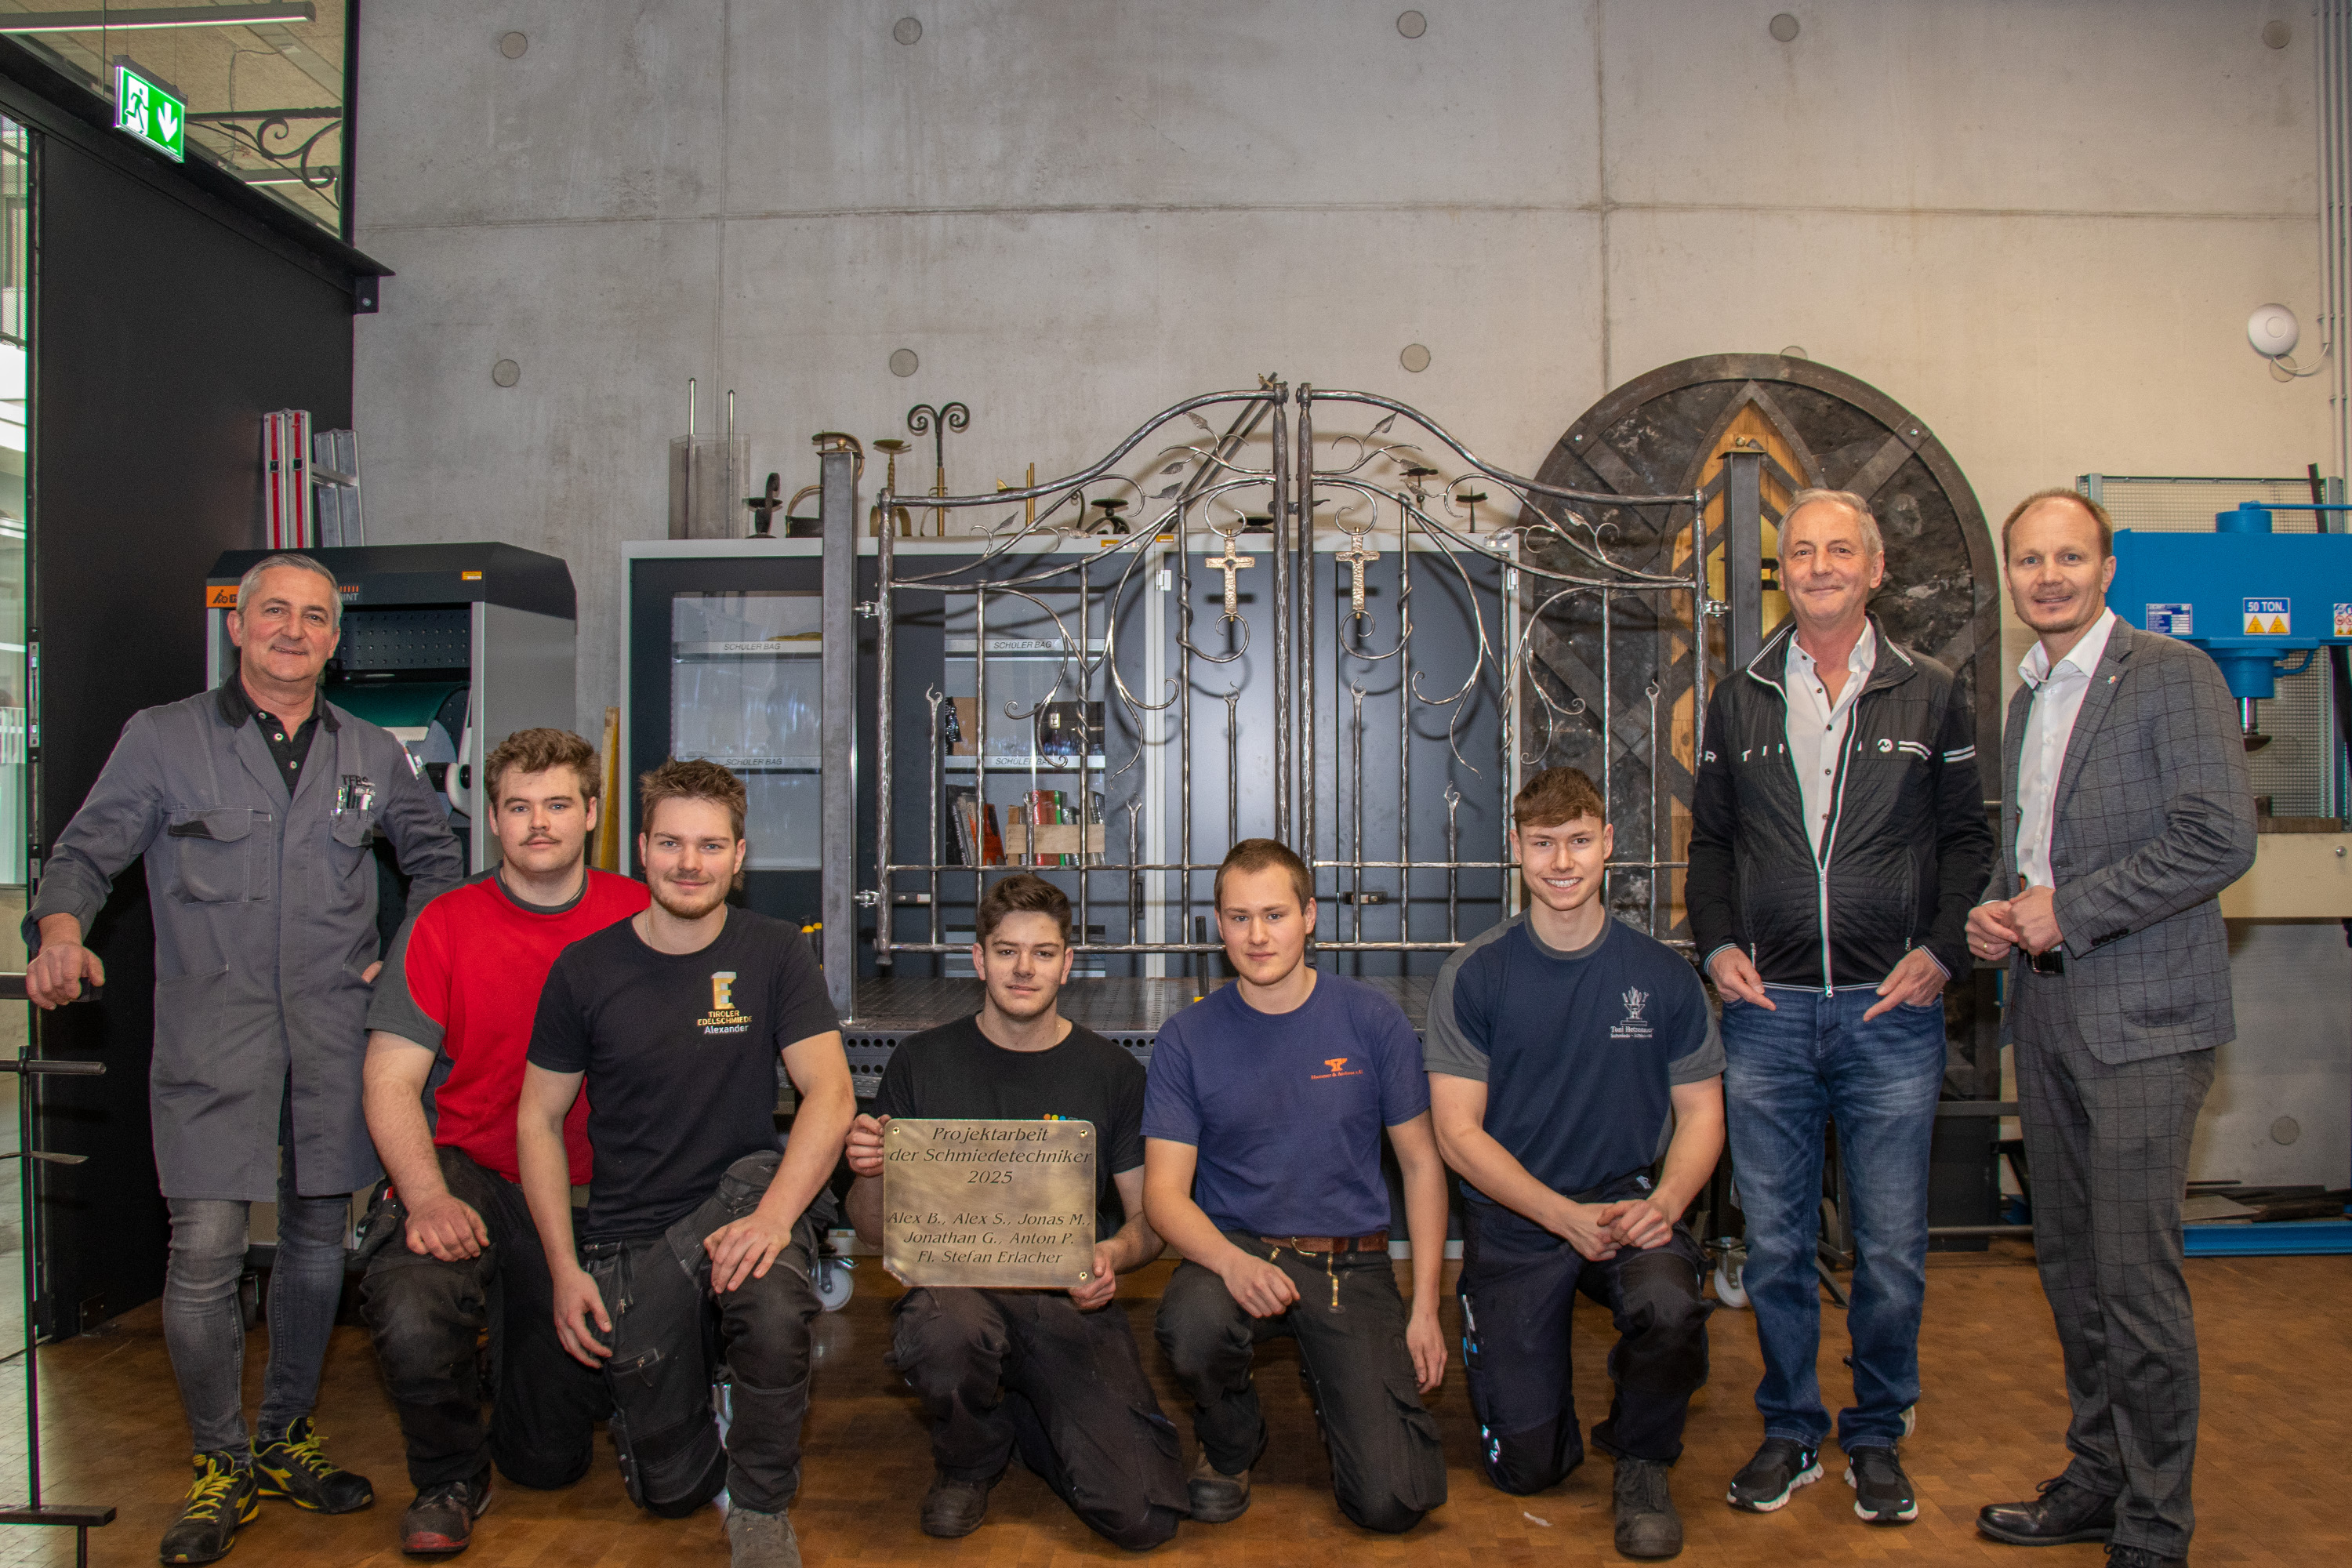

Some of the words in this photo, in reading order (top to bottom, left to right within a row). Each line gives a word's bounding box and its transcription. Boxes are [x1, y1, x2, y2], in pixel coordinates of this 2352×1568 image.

[2248, 601, 2259, 612] 50
[2262, 601, 2285, 612] TON.
[697, 1016, 753, 1026] EDELSCHMIEDE
[708, 1010, 740, 1018] TIROLER
[704, 1025, 750, 1035] Alexander
[932, 1127, 1049, 1144] Projektarbeit
[889, 1148, 920, 1162] der
[924, 1148, 1092, 1163] Schmiedetechniker
[967, 1170, 1013, 1184] 2025
[887, 1212, 922, 1224] Alex
[927, 1212, 946, 1225] B.,
[953, 1212, 988, 1225] Alex
[993, 1212, 1011, 1226] S.,
[1017, 1213, 1065, 1225] Jonas
[1069, 1214, 1091, 1226] M.,
[903, 1231, 977, 1243] Jonathan
[982, 1232, 1002, 1245] G.,
[1009, 1232, 1056, 1244] Anton
[1062, 1232, 1074, 1244] P.
[942, 1250, 993, 1263] Stefan
[996, 1250, 1063, 1264] Erlacher
